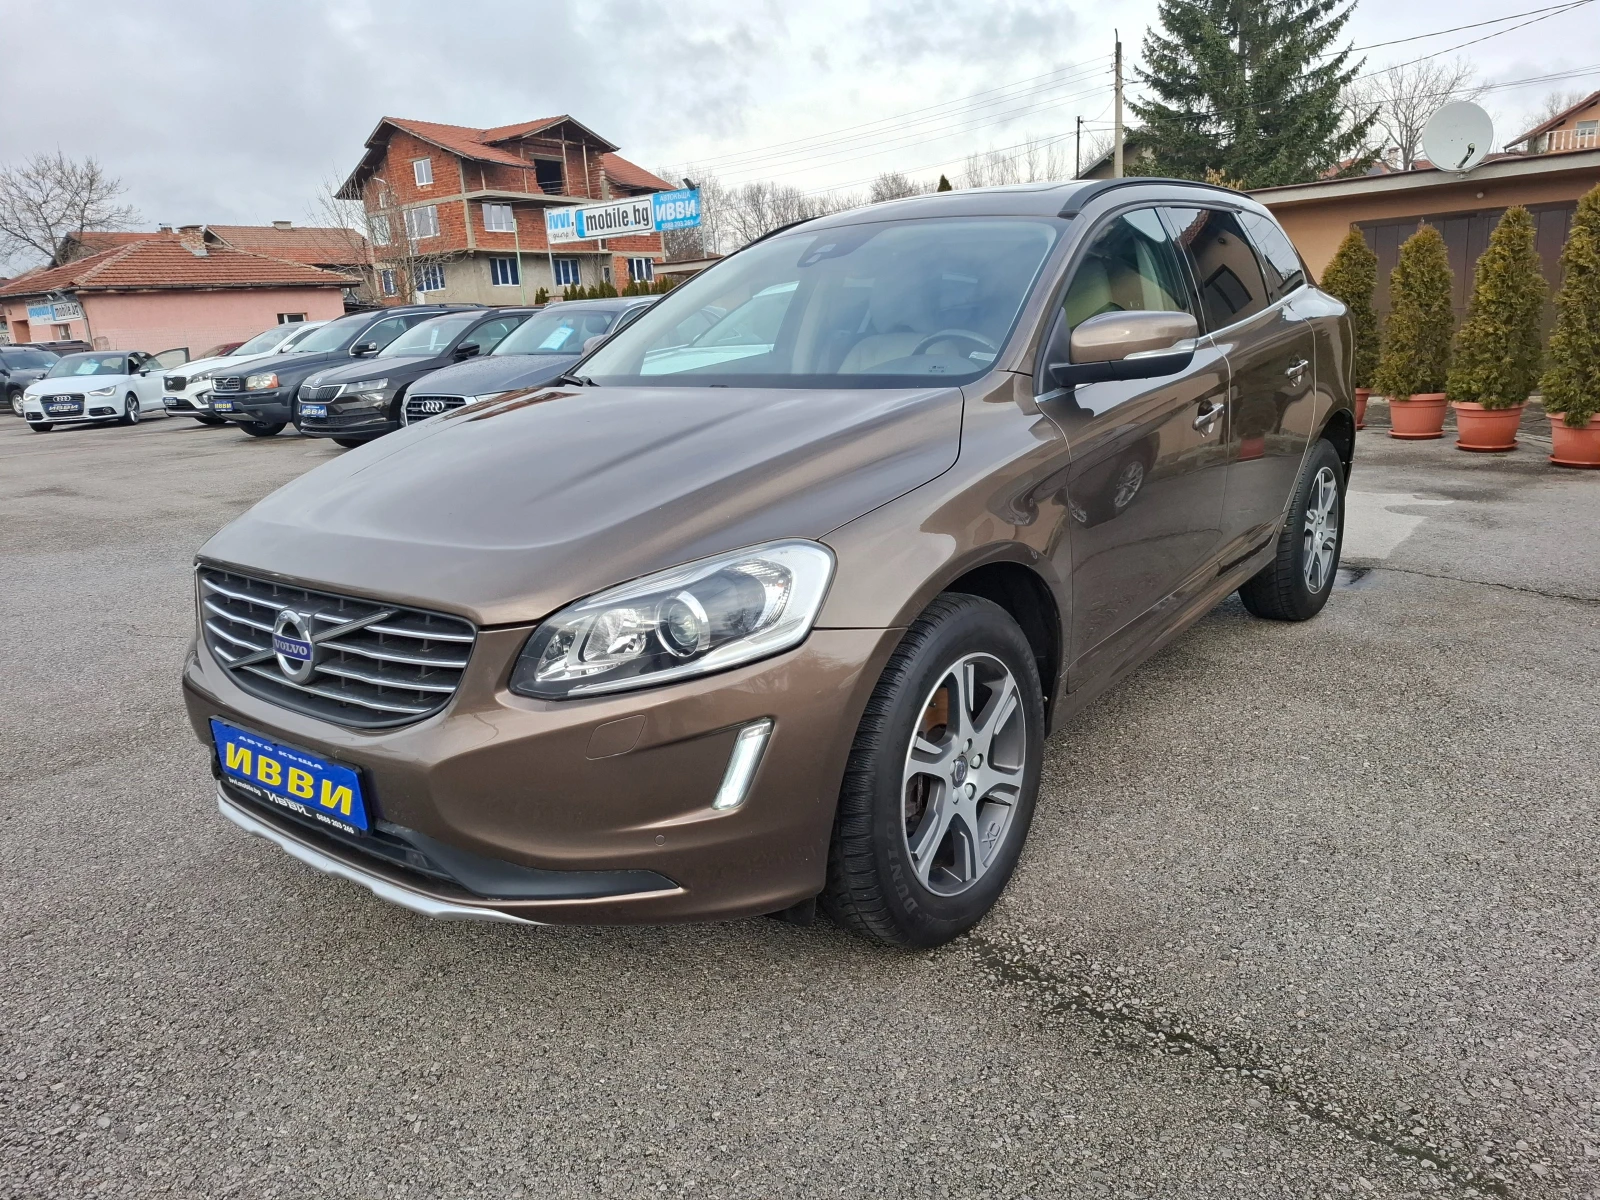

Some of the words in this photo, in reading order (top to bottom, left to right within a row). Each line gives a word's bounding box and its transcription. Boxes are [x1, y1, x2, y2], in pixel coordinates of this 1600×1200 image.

[585, 204, 650, 232] mobile.bg
[655, 199, 696, 222] ИВВИ
[274, 638, 308, 656] VOLVO
[238, 735, 273, 752] АВТО
[278, 750, 323, 770] КЪЩА
[225, 741, 353, 816] ИВВИ
[981, 820, 1001, 849] XC
